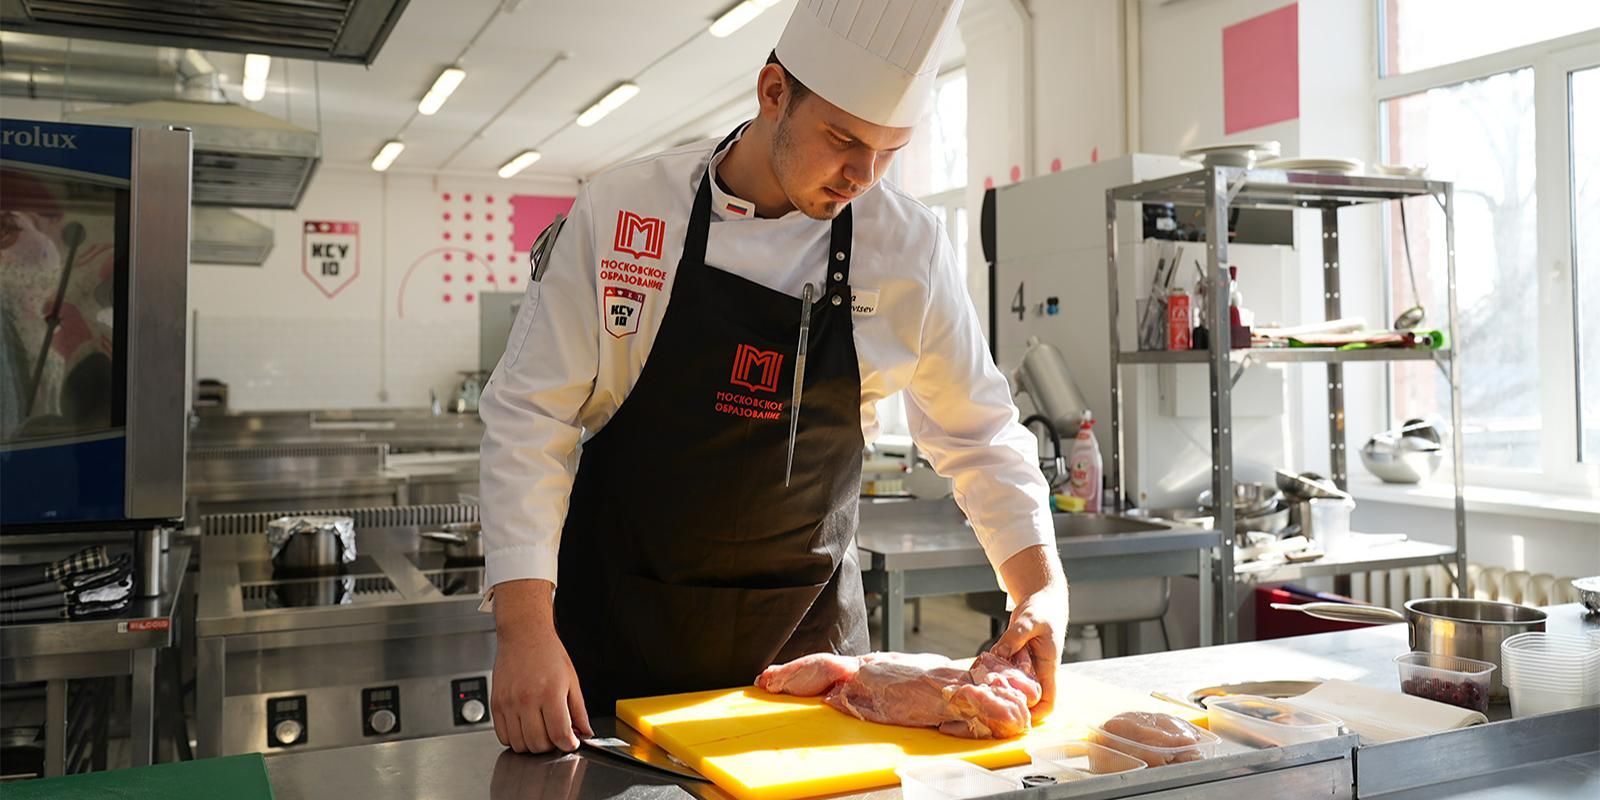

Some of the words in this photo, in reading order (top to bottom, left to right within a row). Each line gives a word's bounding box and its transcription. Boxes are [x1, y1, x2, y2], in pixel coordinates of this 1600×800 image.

[322, 261, 339, 275] 10
[601, 260, 667, 280] МОСКОВСКОЕ
[600, 271, 663, 291] ОБРАЗОВАНИЕ
[1011, 281, 1025, 321] 4
[615, 316, 627, 326] 10
[717, 392, 783, 411] МОСКОВСКОЕ
[715, 403, 780, 420] ОБРАЗОВАНИЕ
